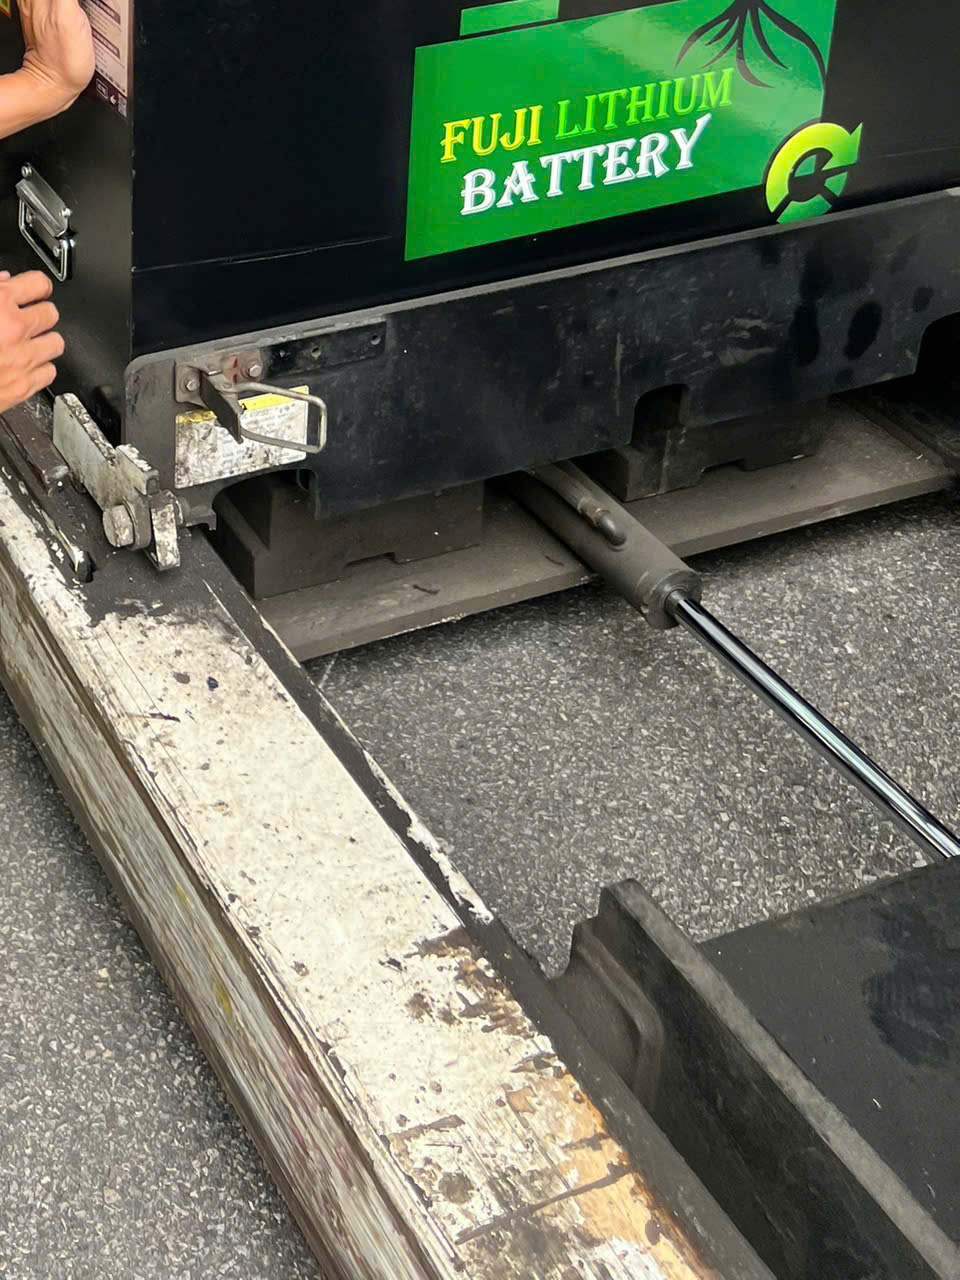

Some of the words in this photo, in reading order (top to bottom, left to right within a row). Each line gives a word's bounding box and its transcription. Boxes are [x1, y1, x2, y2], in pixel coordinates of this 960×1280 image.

[440, 105, 543, 163] FUJI
[554, 67, 734, 141] LITHIUM
[459, 113, 713, 216] BATTERY
